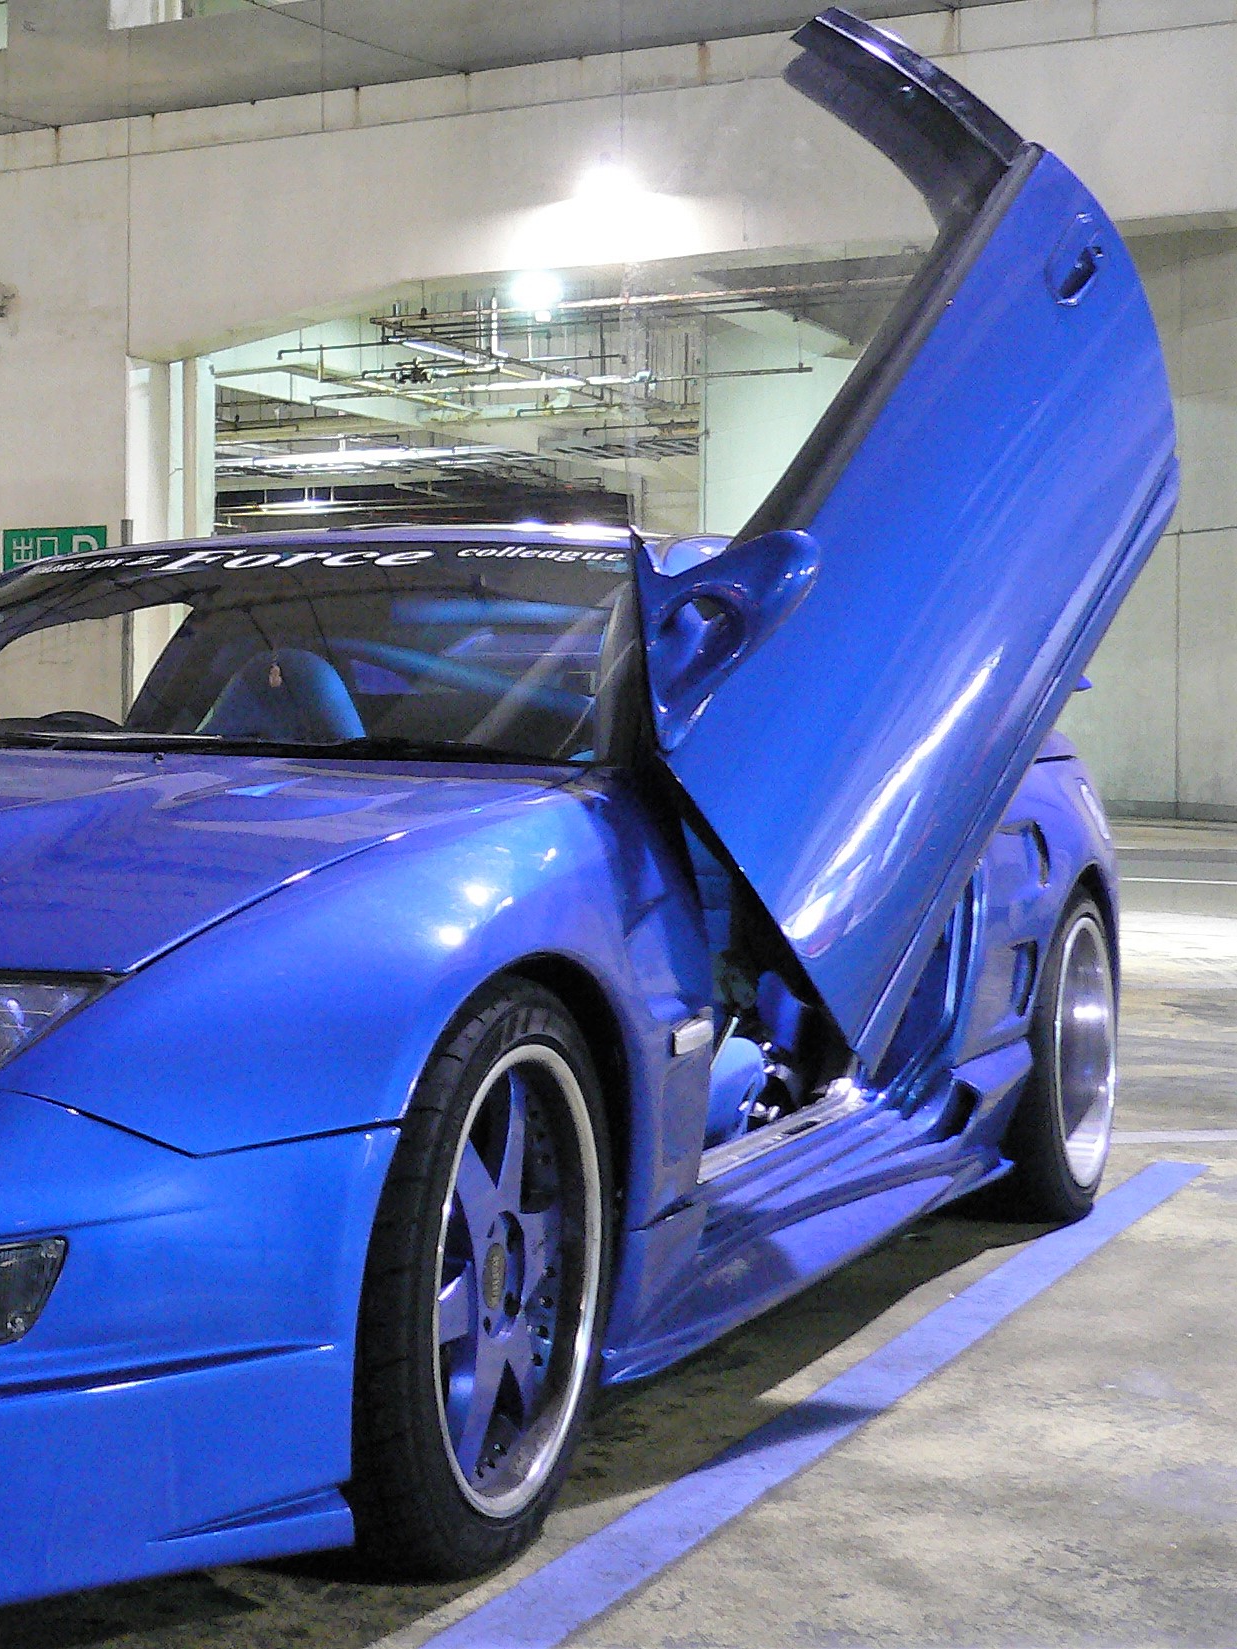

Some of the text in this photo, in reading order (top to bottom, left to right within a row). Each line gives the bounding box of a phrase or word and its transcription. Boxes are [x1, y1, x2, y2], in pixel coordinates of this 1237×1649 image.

[12, 536, 59, 563] 出口
[151, 549, 435, 571] Force
[457, 547, 627, 563] colleague
